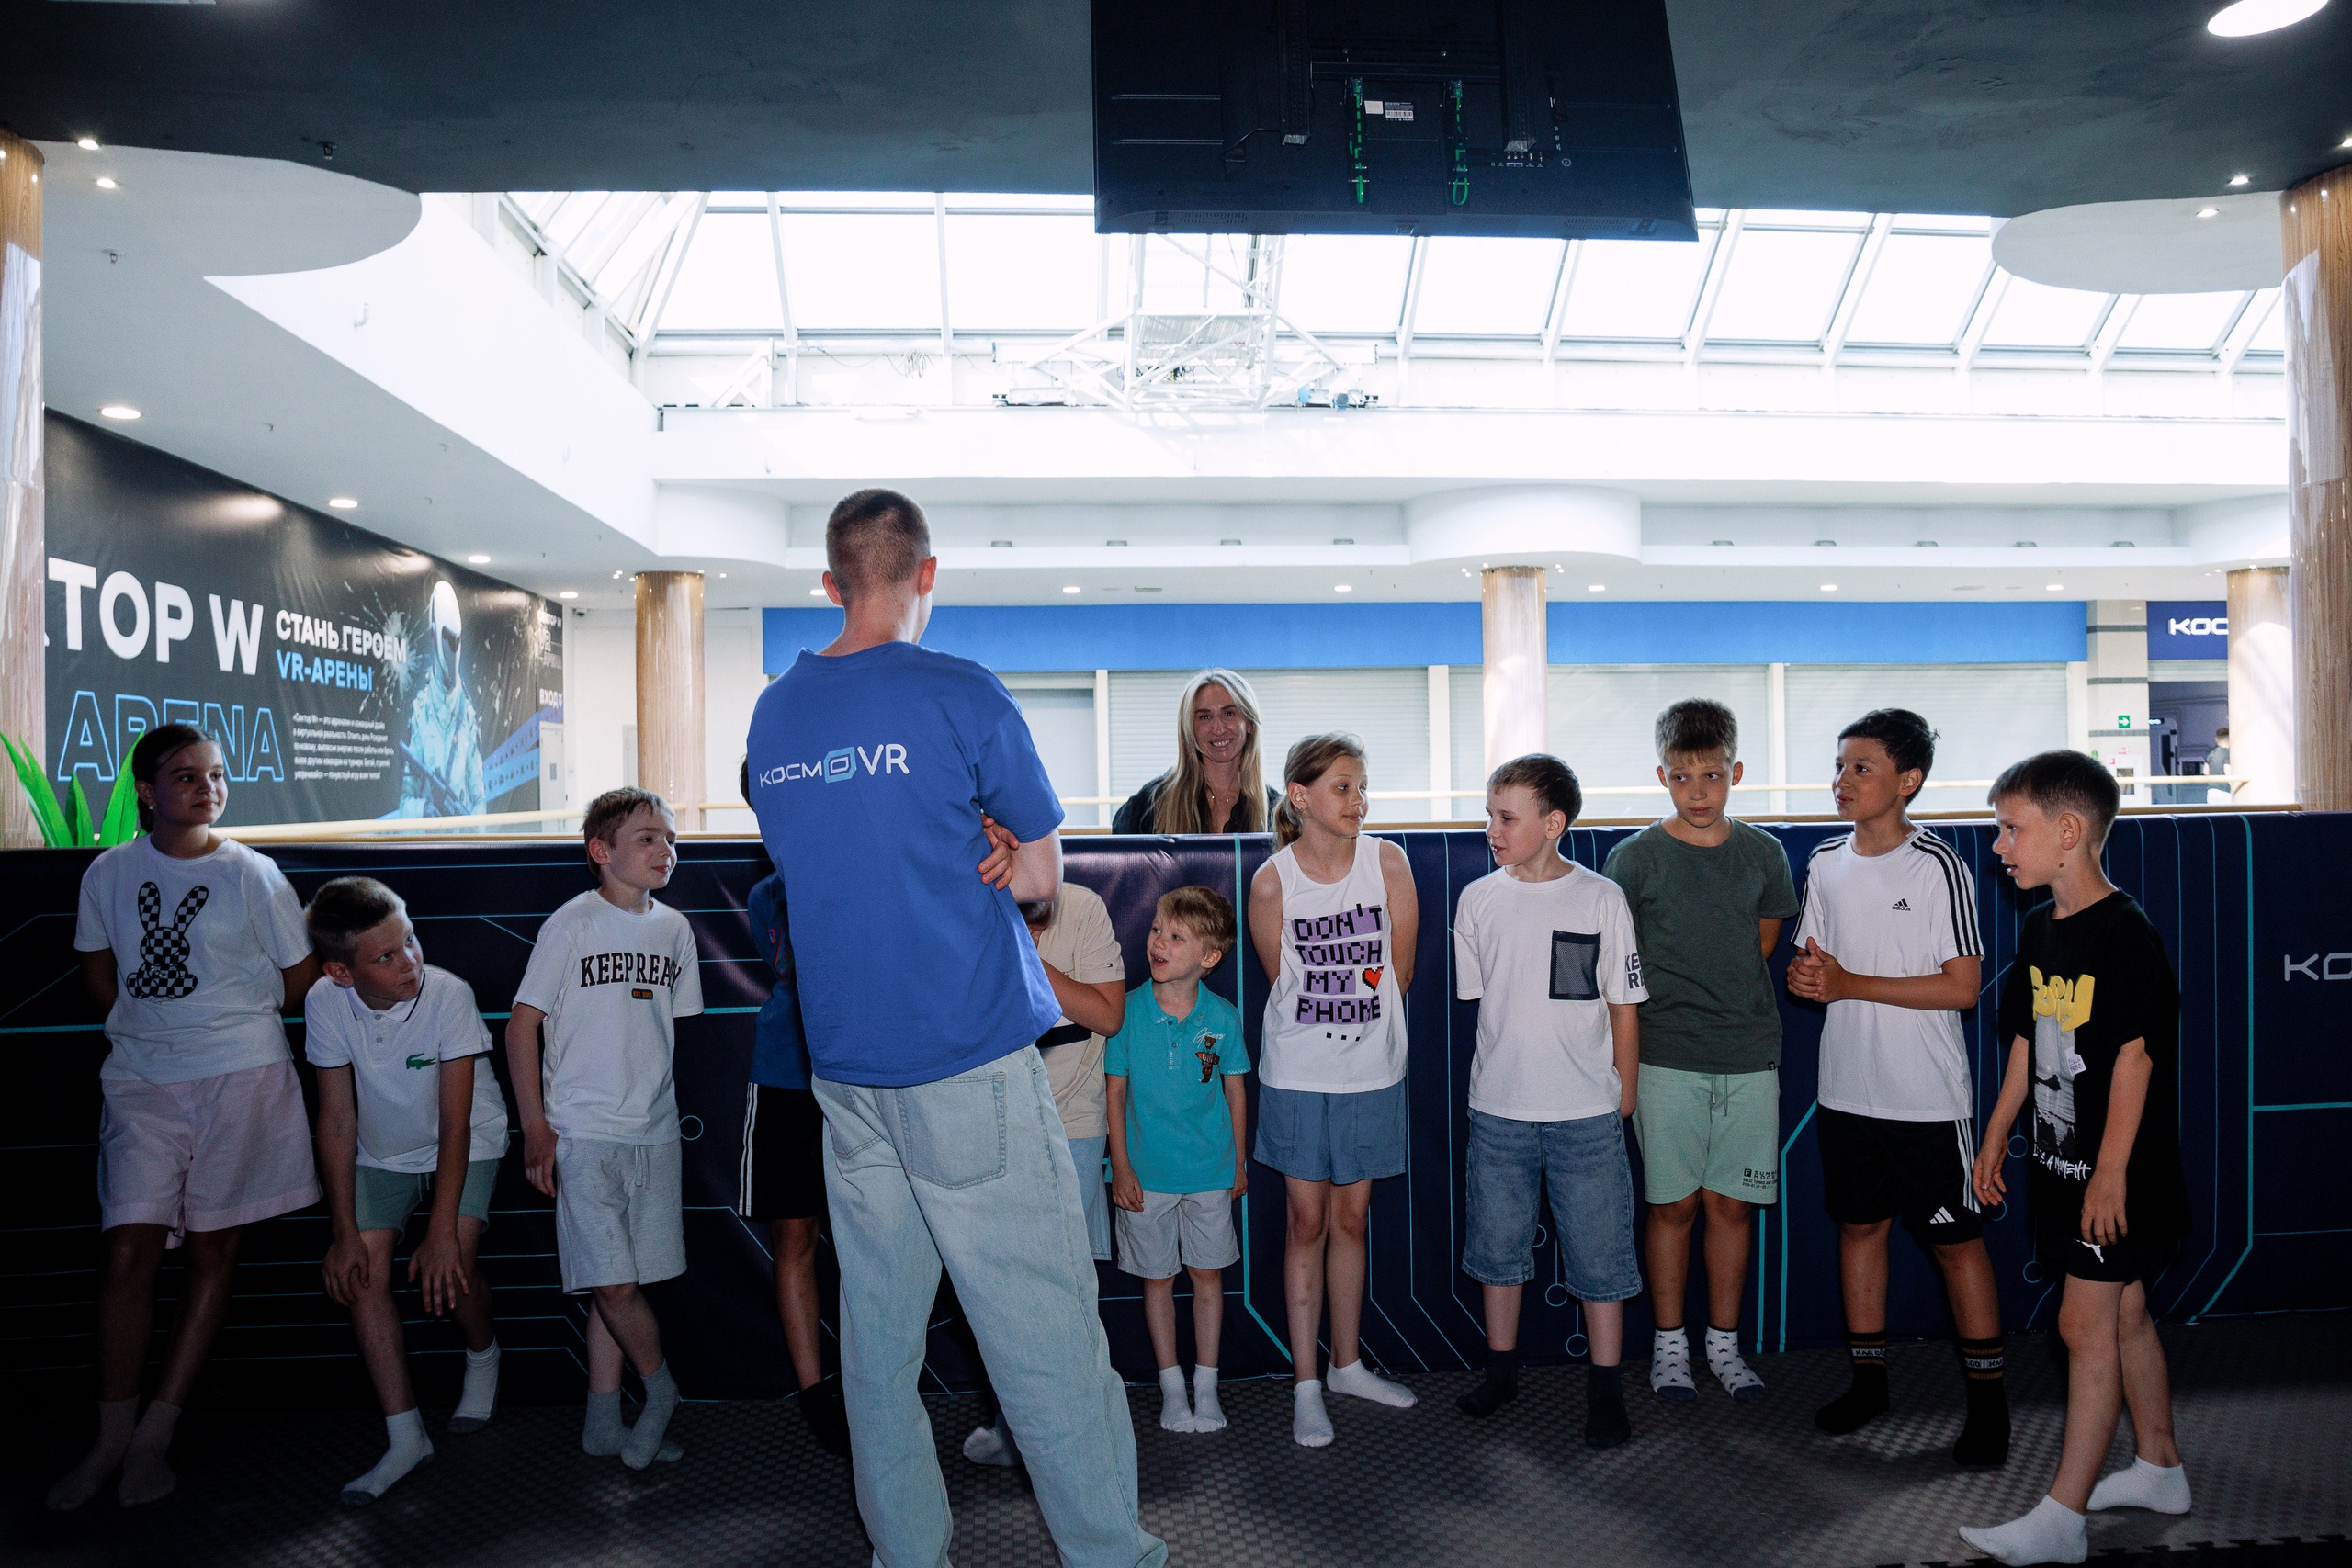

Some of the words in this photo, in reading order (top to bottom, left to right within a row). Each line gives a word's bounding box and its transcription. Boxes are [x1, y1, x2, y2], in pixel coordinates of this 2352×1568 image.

[44, 557, 194, 663] ТОР
[209, 593, 264, 675] W
[276, 609, 340, 650] СТАНЬ
[342, 625, 407, 663] ГЕРОЕМ
[276, 649, 373, 692] VR-АРЕНЫ
[1294, 903, 1383, 941] DON'T
[1295, 940, 1382, 965] TOUCH
[1306, 970, 1353, 993] MY
[1296, 995, 1381, 1022] PHONE
